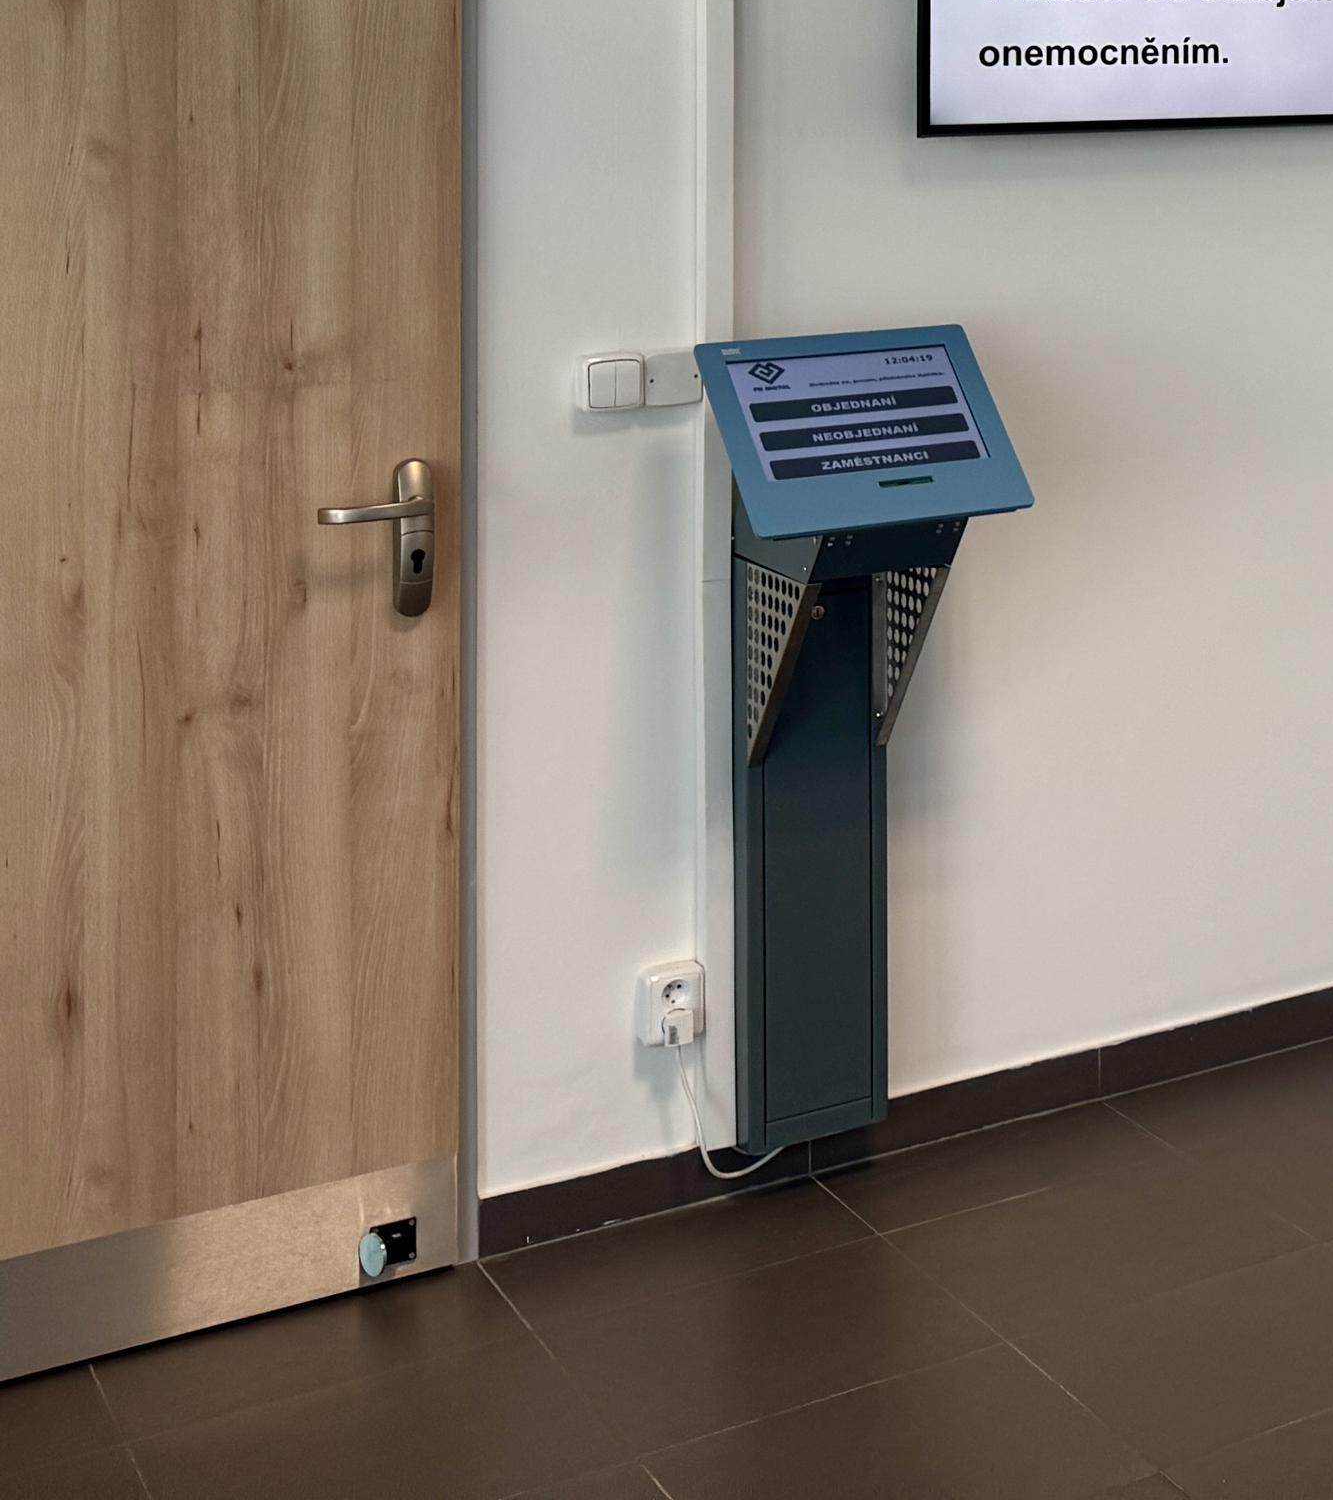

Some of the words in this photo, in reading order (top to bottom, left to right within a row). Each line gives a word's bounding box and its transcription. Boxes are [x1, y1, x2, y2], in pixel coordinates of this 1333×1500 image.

[979, 37, 1228, 66] onemocněním.
[884, 354, 933, 366] 12:04:19
[810, 395, 897, 414] OBJEDNANÍ
[812, 422, 919, 443] NEOBJEDNANÍ
